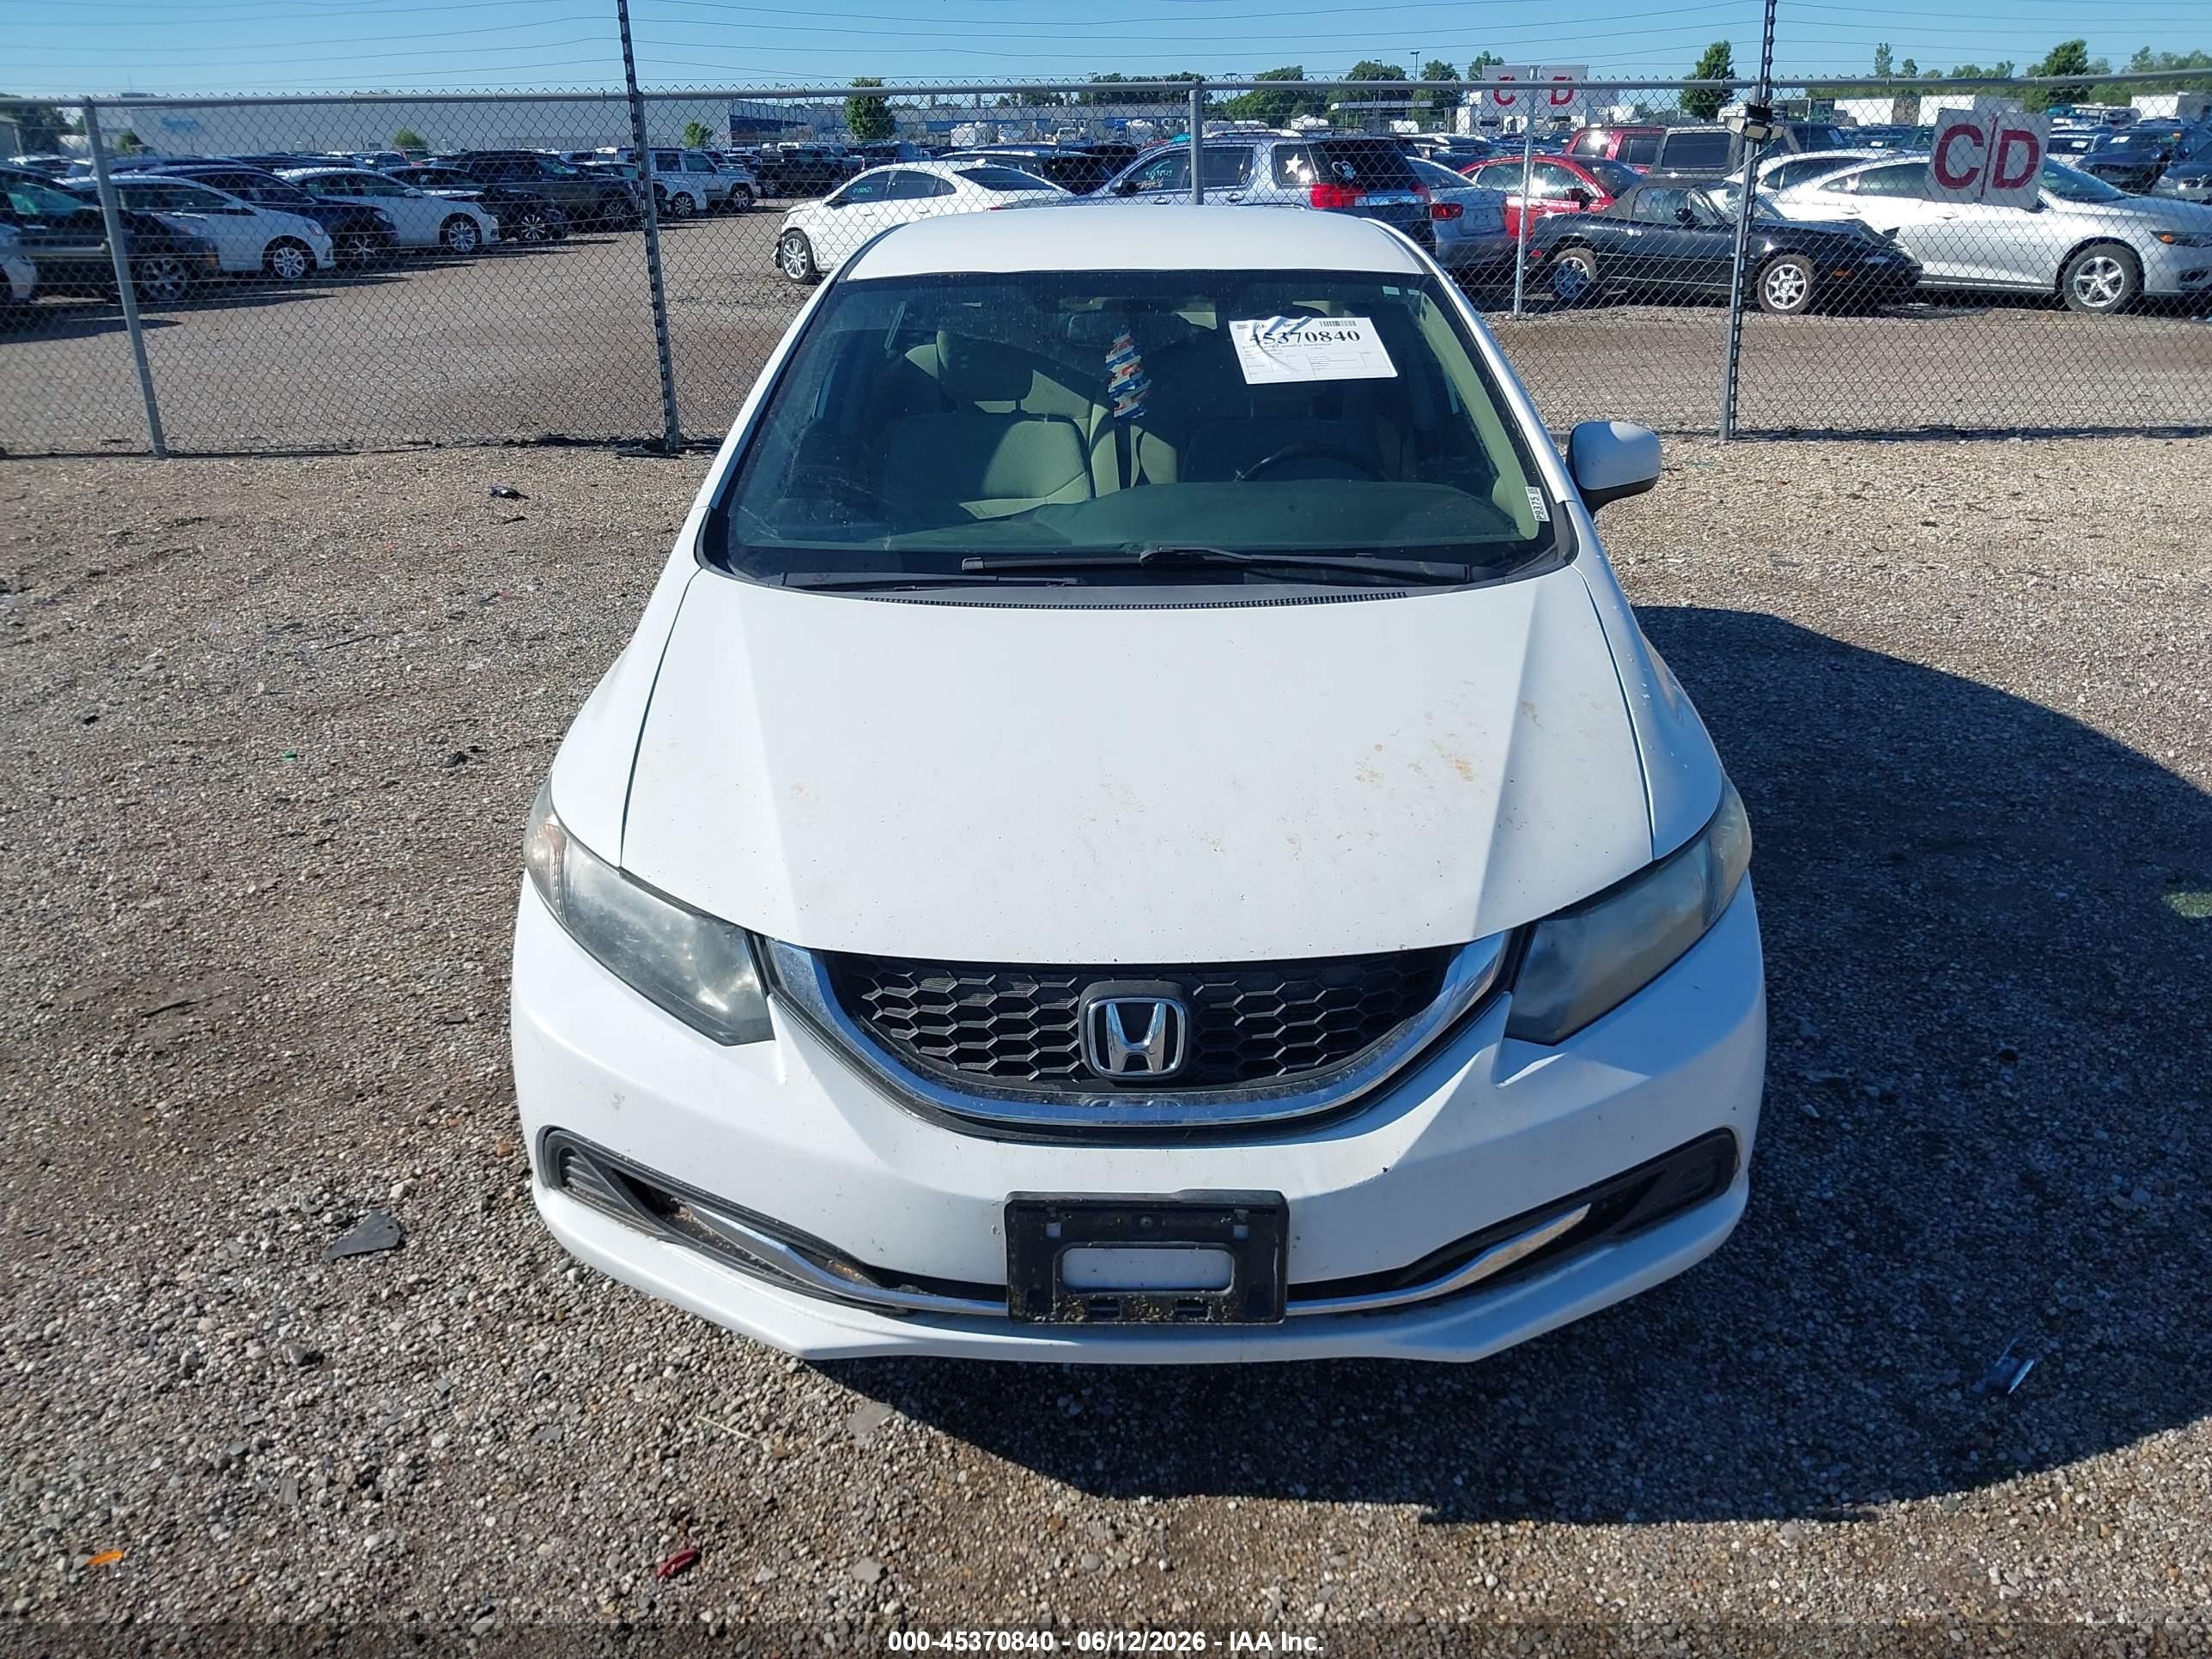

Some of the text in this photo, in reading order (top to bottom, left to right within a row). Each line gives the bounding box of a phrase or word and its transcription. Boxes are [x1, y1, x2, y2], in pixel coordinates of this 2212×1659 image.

[1494, 76, 1574, 106] C D
[1250, 330, 1360, 344] 45370840
